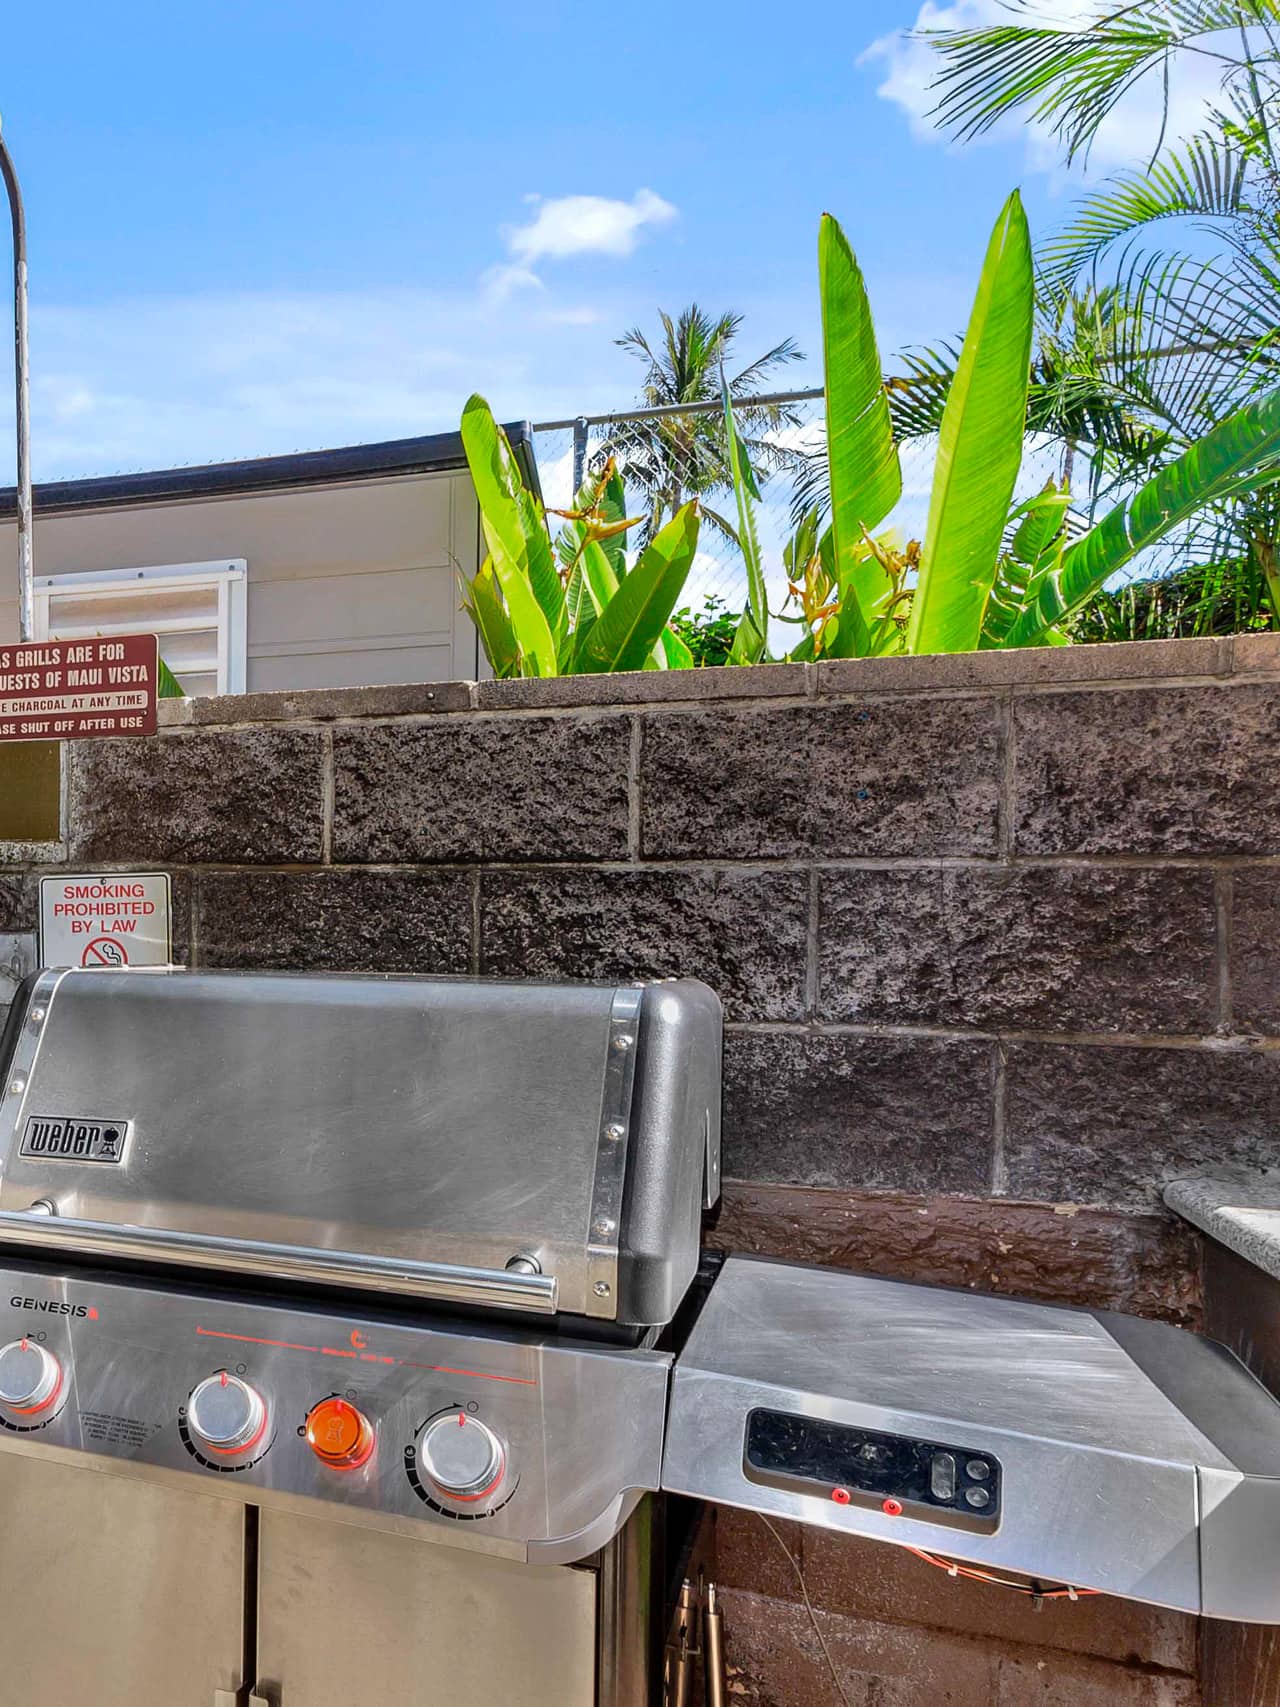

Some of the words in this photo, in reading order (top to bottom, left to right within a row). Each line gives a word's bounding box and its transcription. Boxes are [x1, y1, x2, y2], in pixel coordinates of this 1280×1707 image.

[16, 648, 60, 668] GRILLS
[66, 646, 93, 663] ARE
[99, 644, 124, 661] FOR
[46, 671, 62, 688] OF
[68, 668, 102, 686] MAUI
[108, 665, 148, 684] VISTA
[12, 699, 67, 713] CHARCOAL
[72, 698, 85, 708] AT
[90, 696, 111, 708] ANY
[116, 694, 142, 706] TIME
[21, 722, 50, 733] SHUT
[54, 720, 74, 732] OFF
[79, 718, 115, 730] AFTER
[120, 716, 143, 728] USE
[64, 884, 145, 899] SMOKING
[54, 901, 155, 916] PROHIBITED
[72, 920, 93, 933] BY
[101, 920, 136, 933] LAW
[29, 1119, 101, 1155] weber
[10, 1296, 88, 1317] GENESIS
